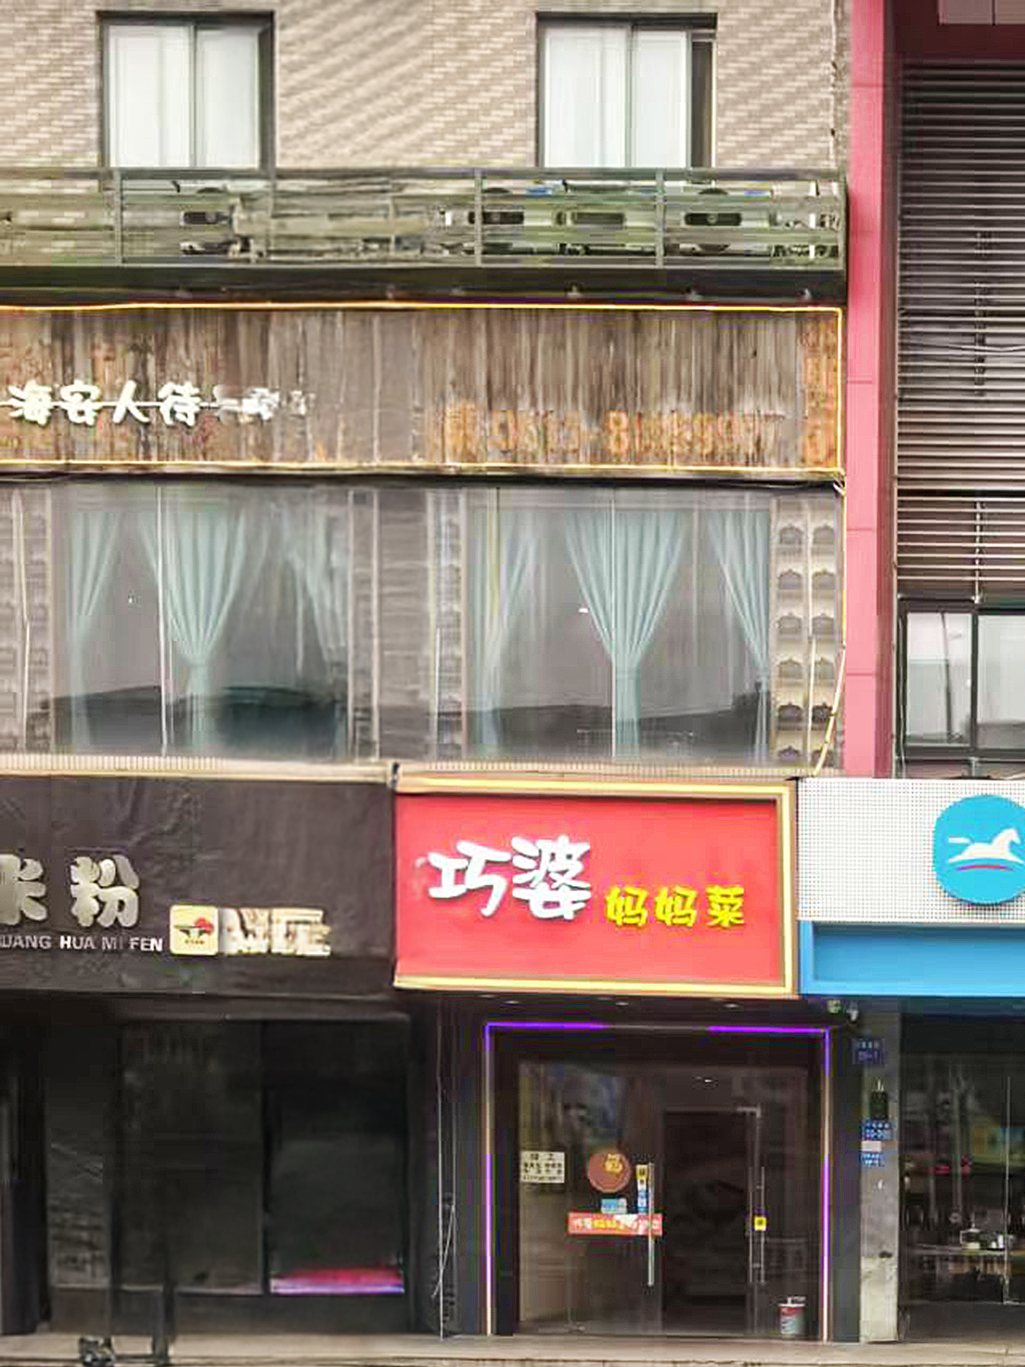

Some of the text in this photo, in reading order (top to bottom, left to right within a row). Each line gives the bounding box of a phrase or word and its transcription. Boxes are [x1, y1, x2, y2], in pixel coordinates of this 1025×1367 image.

[428, 835, 745, 928] 巧婆 妈妈菜
[60, 935, 96, 950] HUA
[102, 936, 124, 950] MI
[129, 937, 164, 951] FEN
